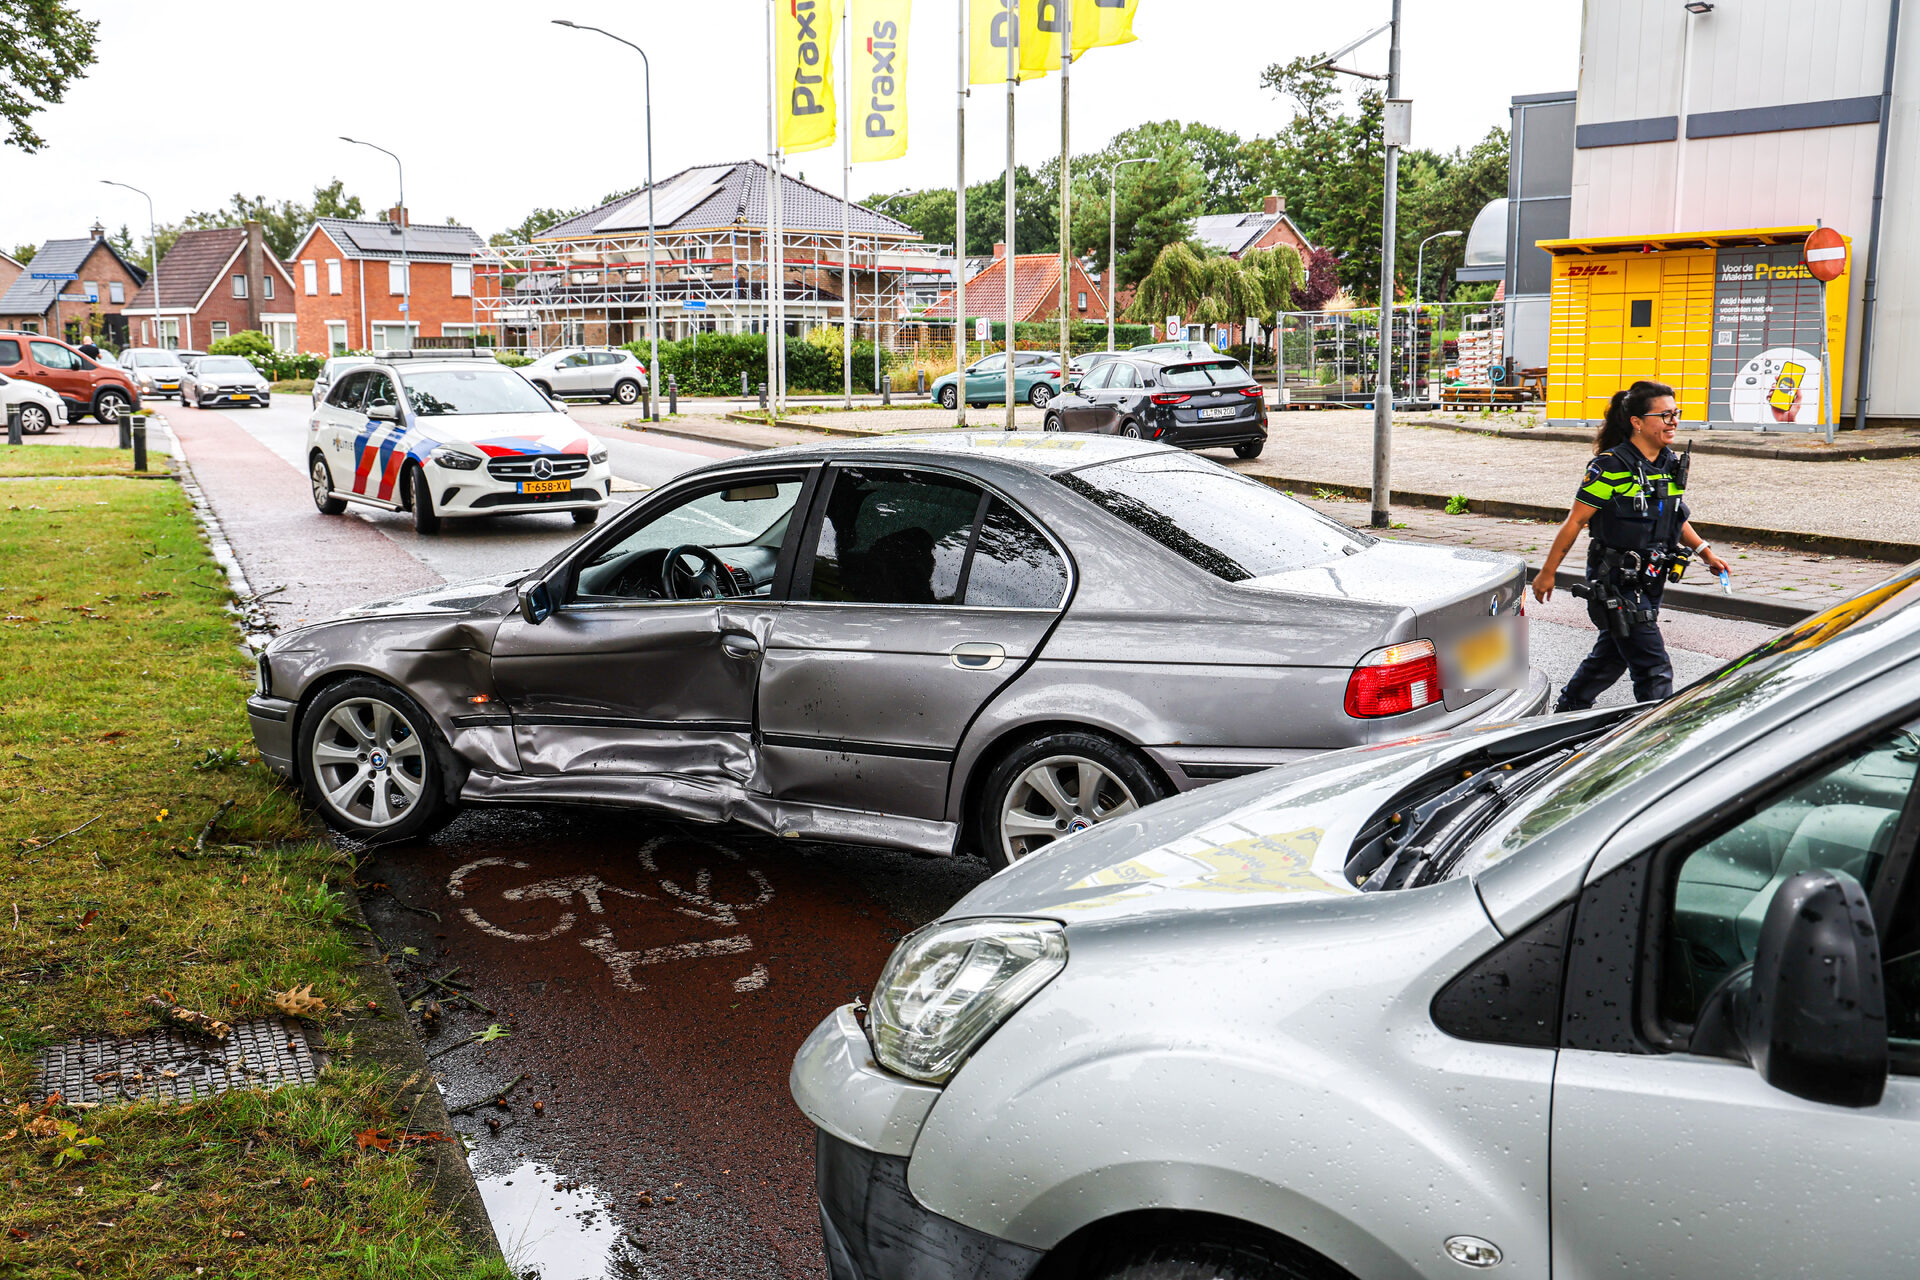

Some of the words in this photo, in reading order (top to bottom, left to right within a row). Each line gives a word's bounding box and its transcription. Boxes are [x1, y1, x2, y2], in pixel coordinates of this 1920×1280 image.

[791, 0, 825, 116] Praxi
[865, 20, 897, 138] Praxis
[1568, 265, 1608, 276] DHL
[1722, 264, 1742, 273] Voor
[1743, 263, 1753, 272] de
[1755, 261, 1813, 280] Praxis
[1721, 273, 1753, 281] Makers
[526, 481, 568, 492] T-658-XV
